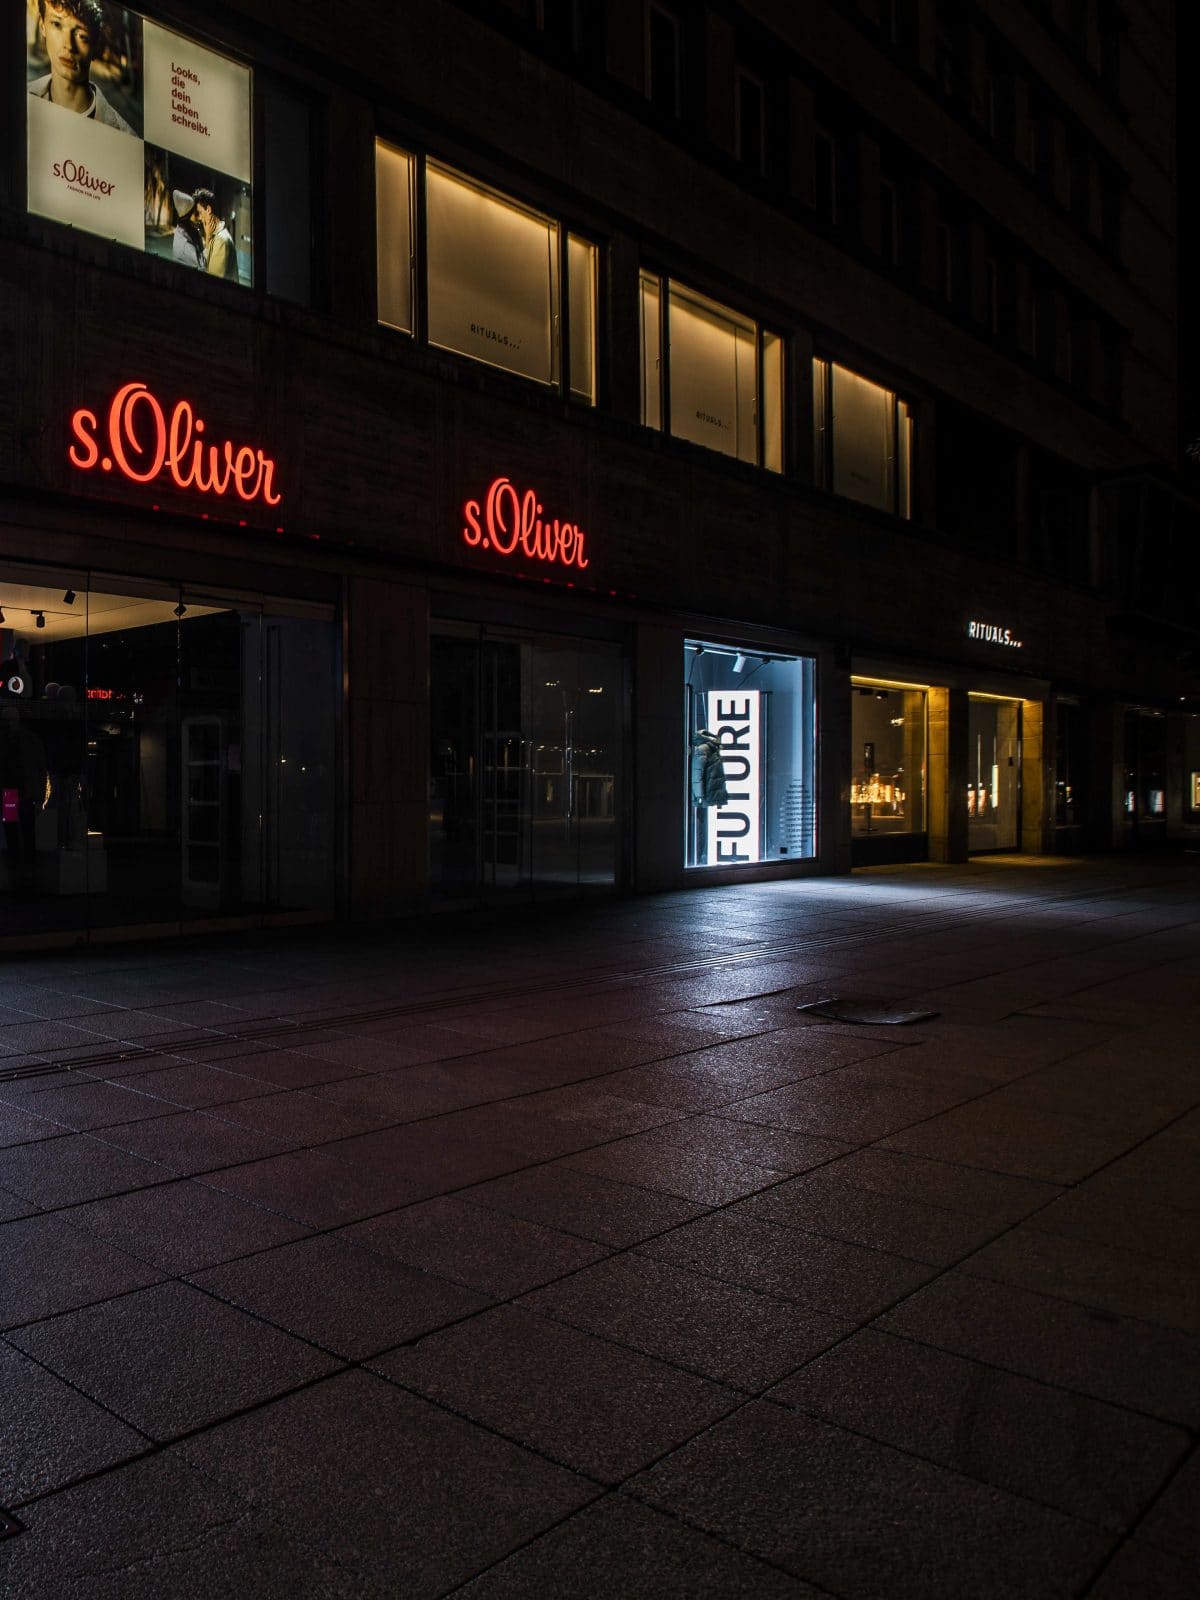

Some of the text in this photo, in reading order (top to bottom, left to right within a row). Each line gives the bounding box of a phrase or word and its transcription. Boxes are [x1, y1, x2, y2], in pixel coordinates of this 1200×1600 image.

[171, 62, 201, 85] Looks,
[171, 75, 185, 89] die
[171, 88, 191, 104] dein
[171, 99, 199, 120] Leben
[171, 113, 211, 136] schreibt.
[53, 159, 116, 196] s.Oliver
[69, 382, 281, 505] s.Oliver
[463, 477, 589, 569] s.Oliver
[968, 620, 1023, 648] RITUALS...
